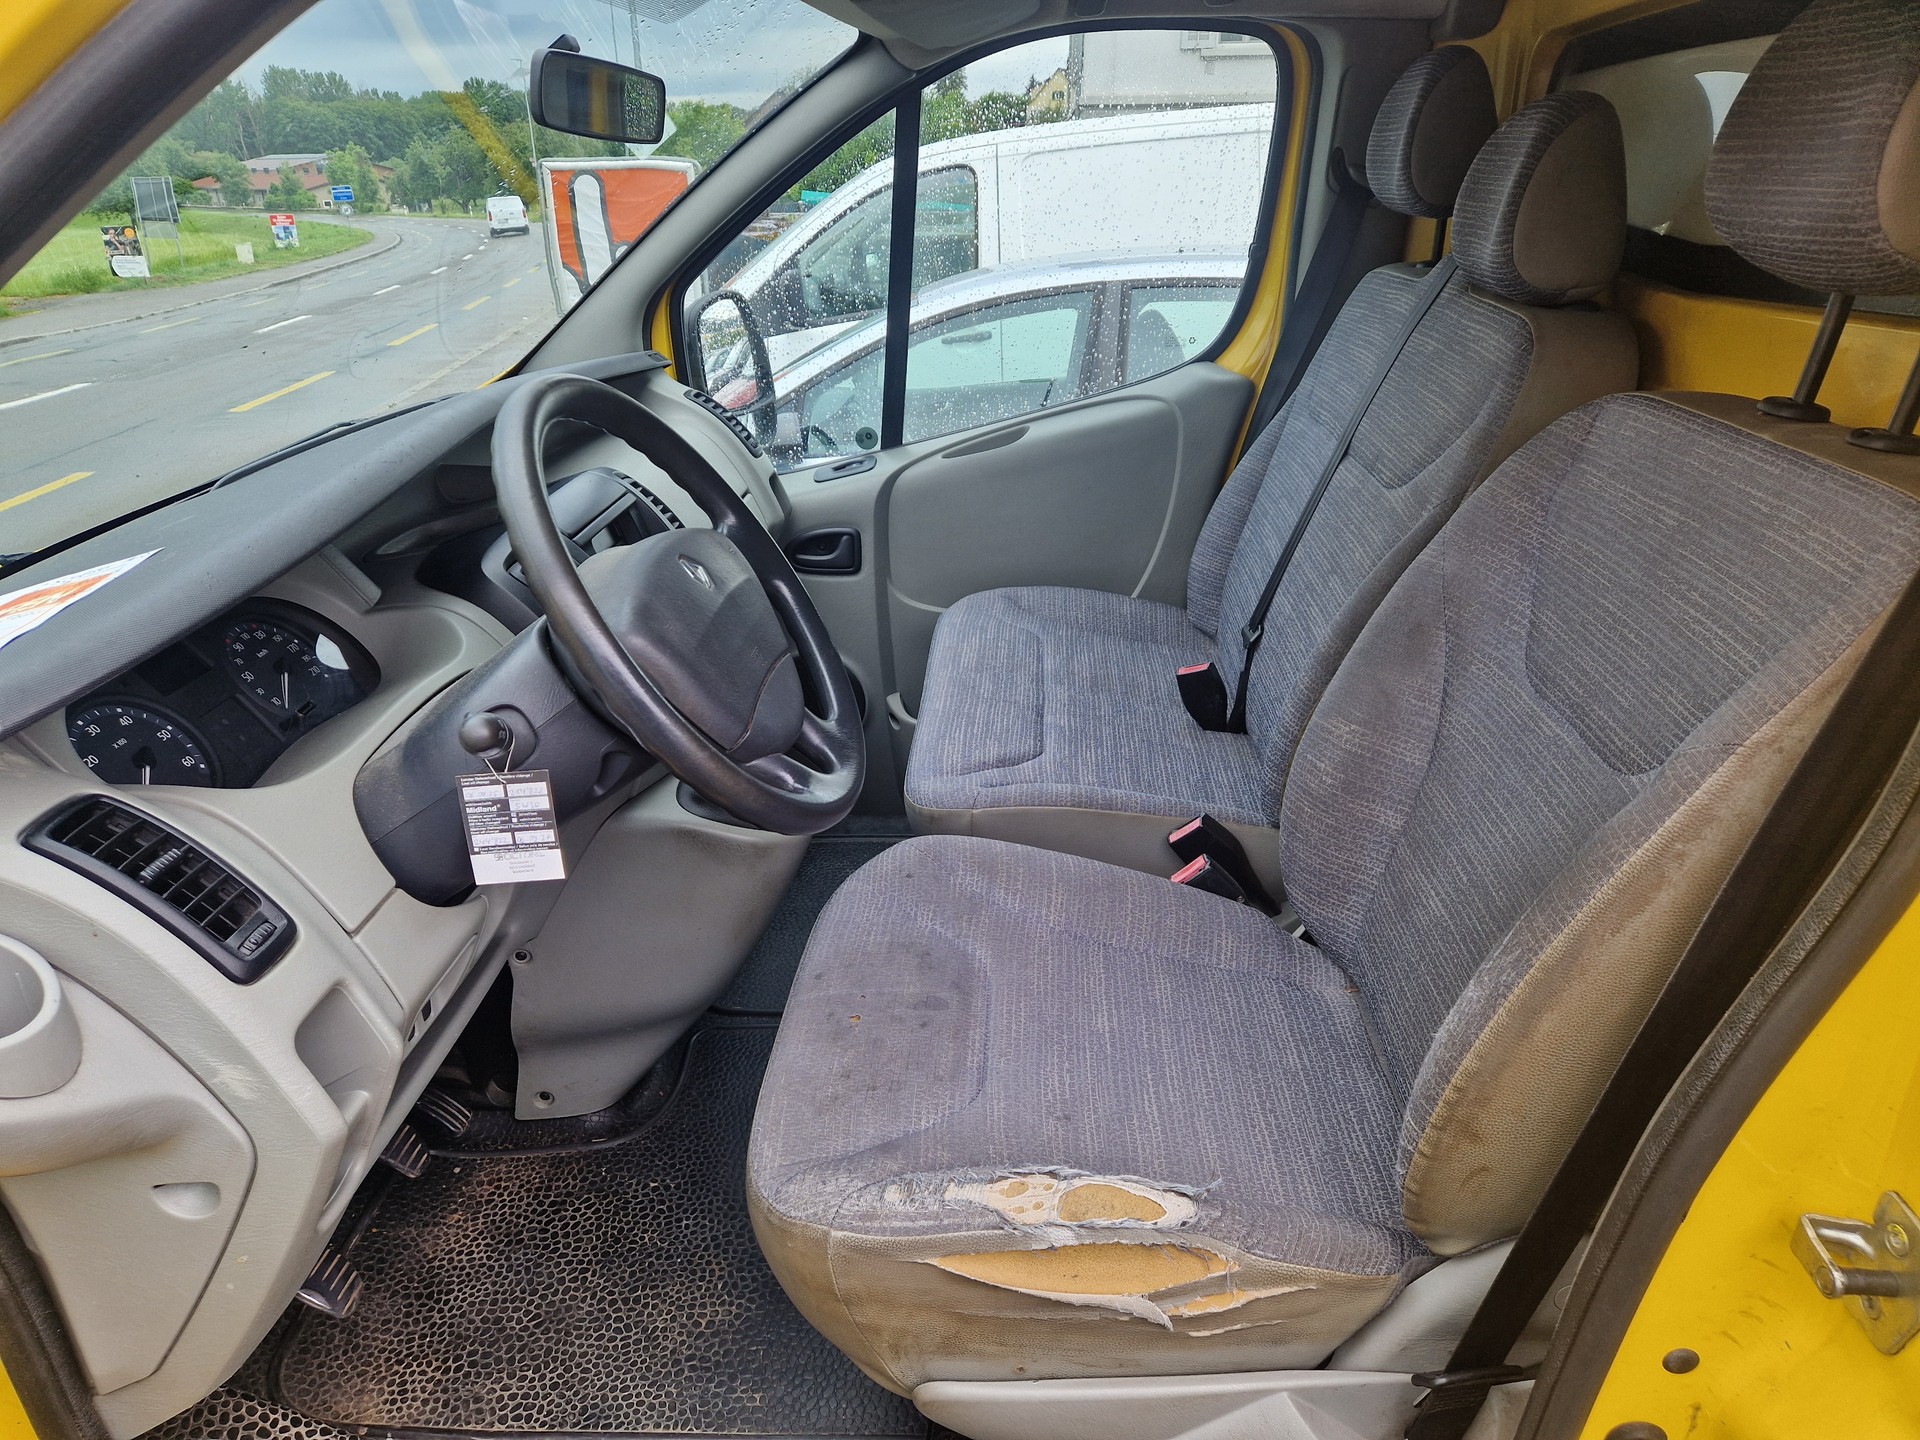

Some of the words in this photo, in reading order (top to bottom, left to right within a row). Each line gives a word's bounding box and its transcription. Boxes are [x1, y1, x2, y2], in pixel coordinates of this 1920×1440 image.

[240, 632, 251, 641] 110
[253, 630, 267, 640] 130
[232, 642, 245, 652] 90
[286, 643, 300, 653] 170
[256, 648, 269, 658] km/h
[234, 658, 244, 666] 70
[308, 665, 321, 676] 210
[241, 671, 255, 683] 50
[256, 687, 265, 696] 30
[270, 696, 282, 706] 10
[119, 715, 134, 726] 40
[85, 724, 101, 737] 30
[157, 729, 171, 741] 50
[83, 754, 99, 768] 20
[181, 755, 195, 767] 60
[466, 805, 497, 813] Midland
